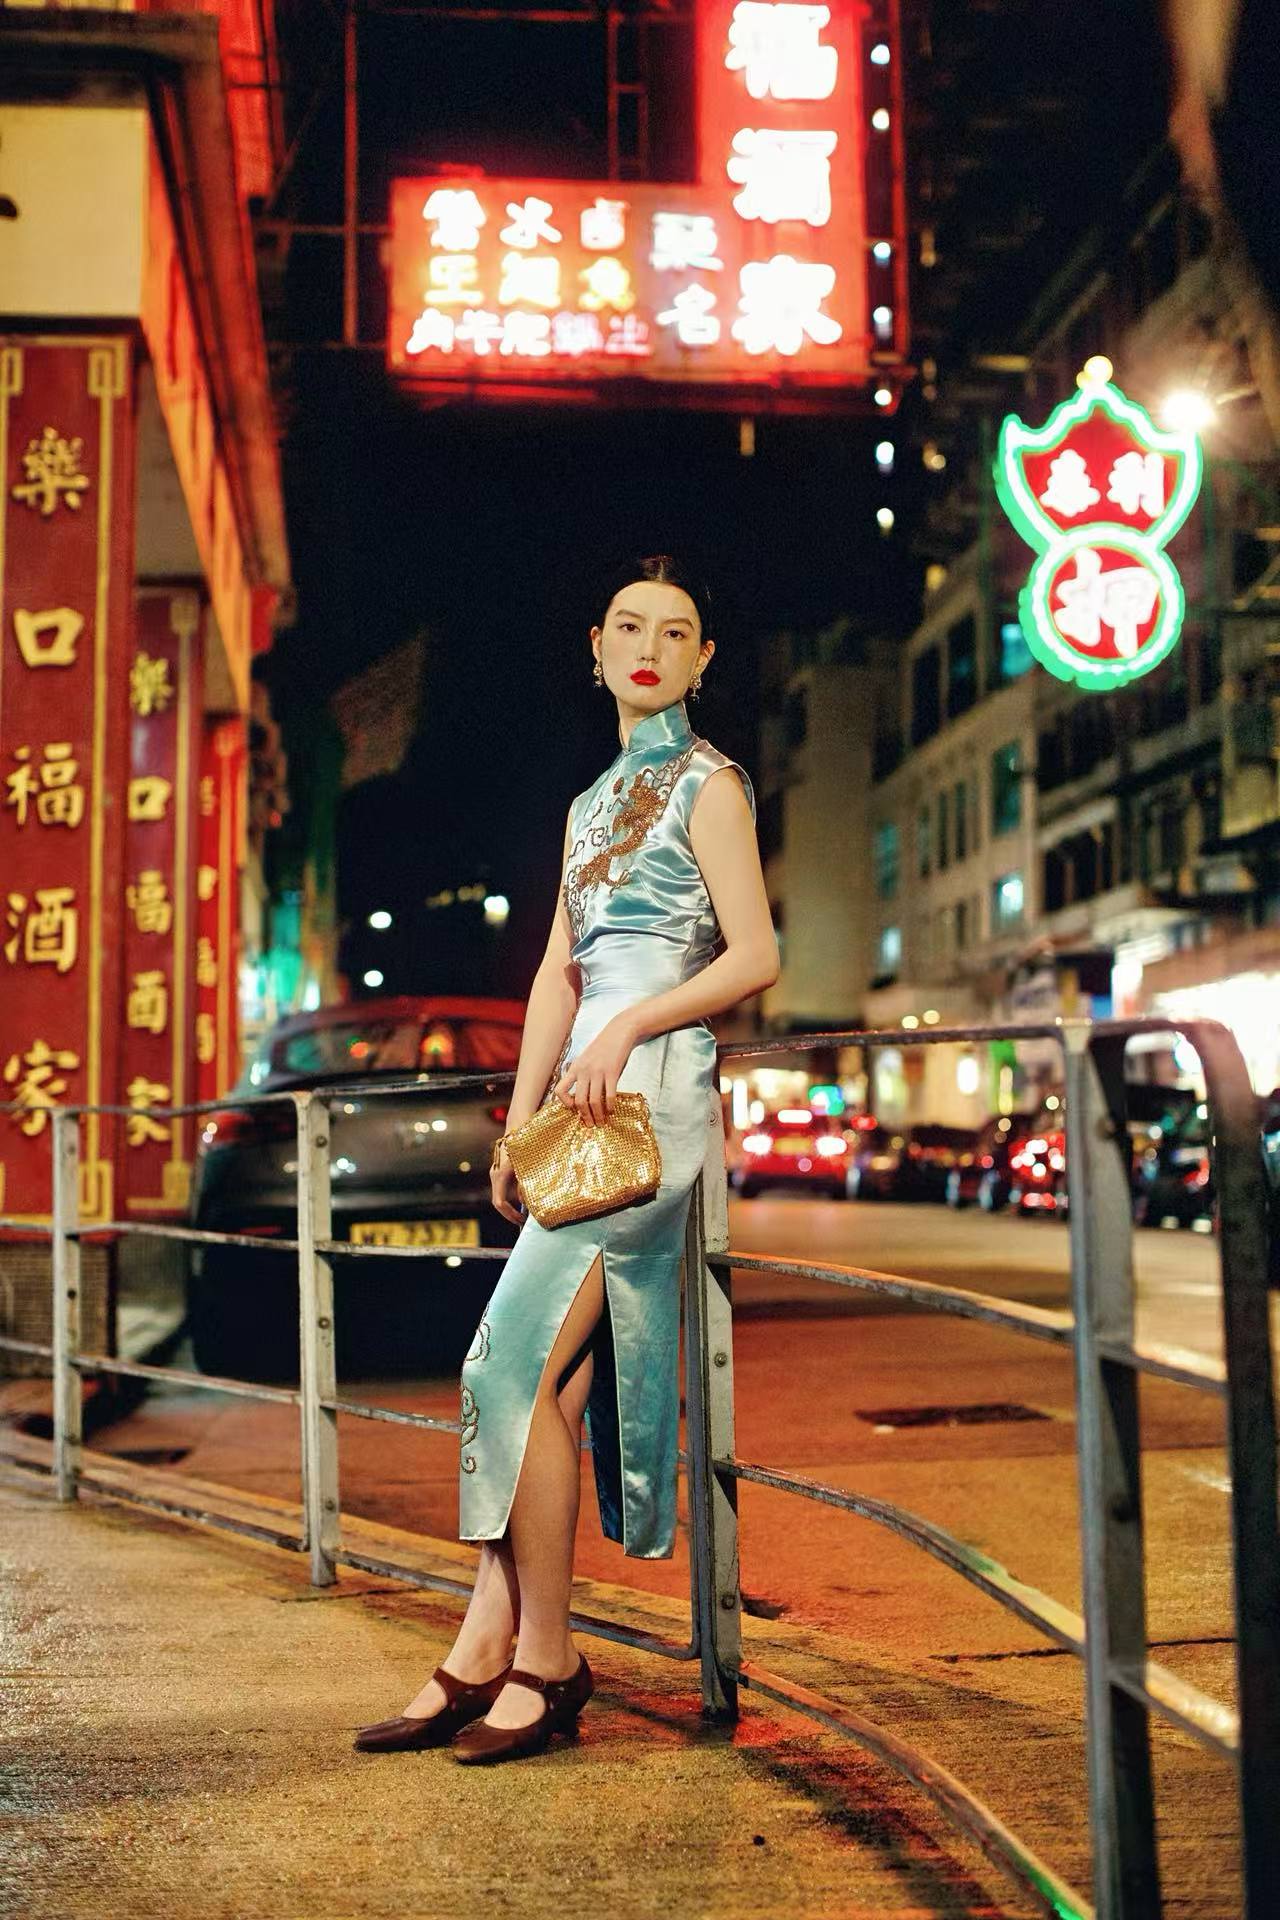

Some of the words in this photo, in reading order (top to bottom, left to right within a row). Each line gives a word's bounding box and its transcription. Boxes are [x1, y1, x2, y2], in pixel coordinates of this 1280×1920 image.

[4, 427, 89, 1137] 樂口福酒家
